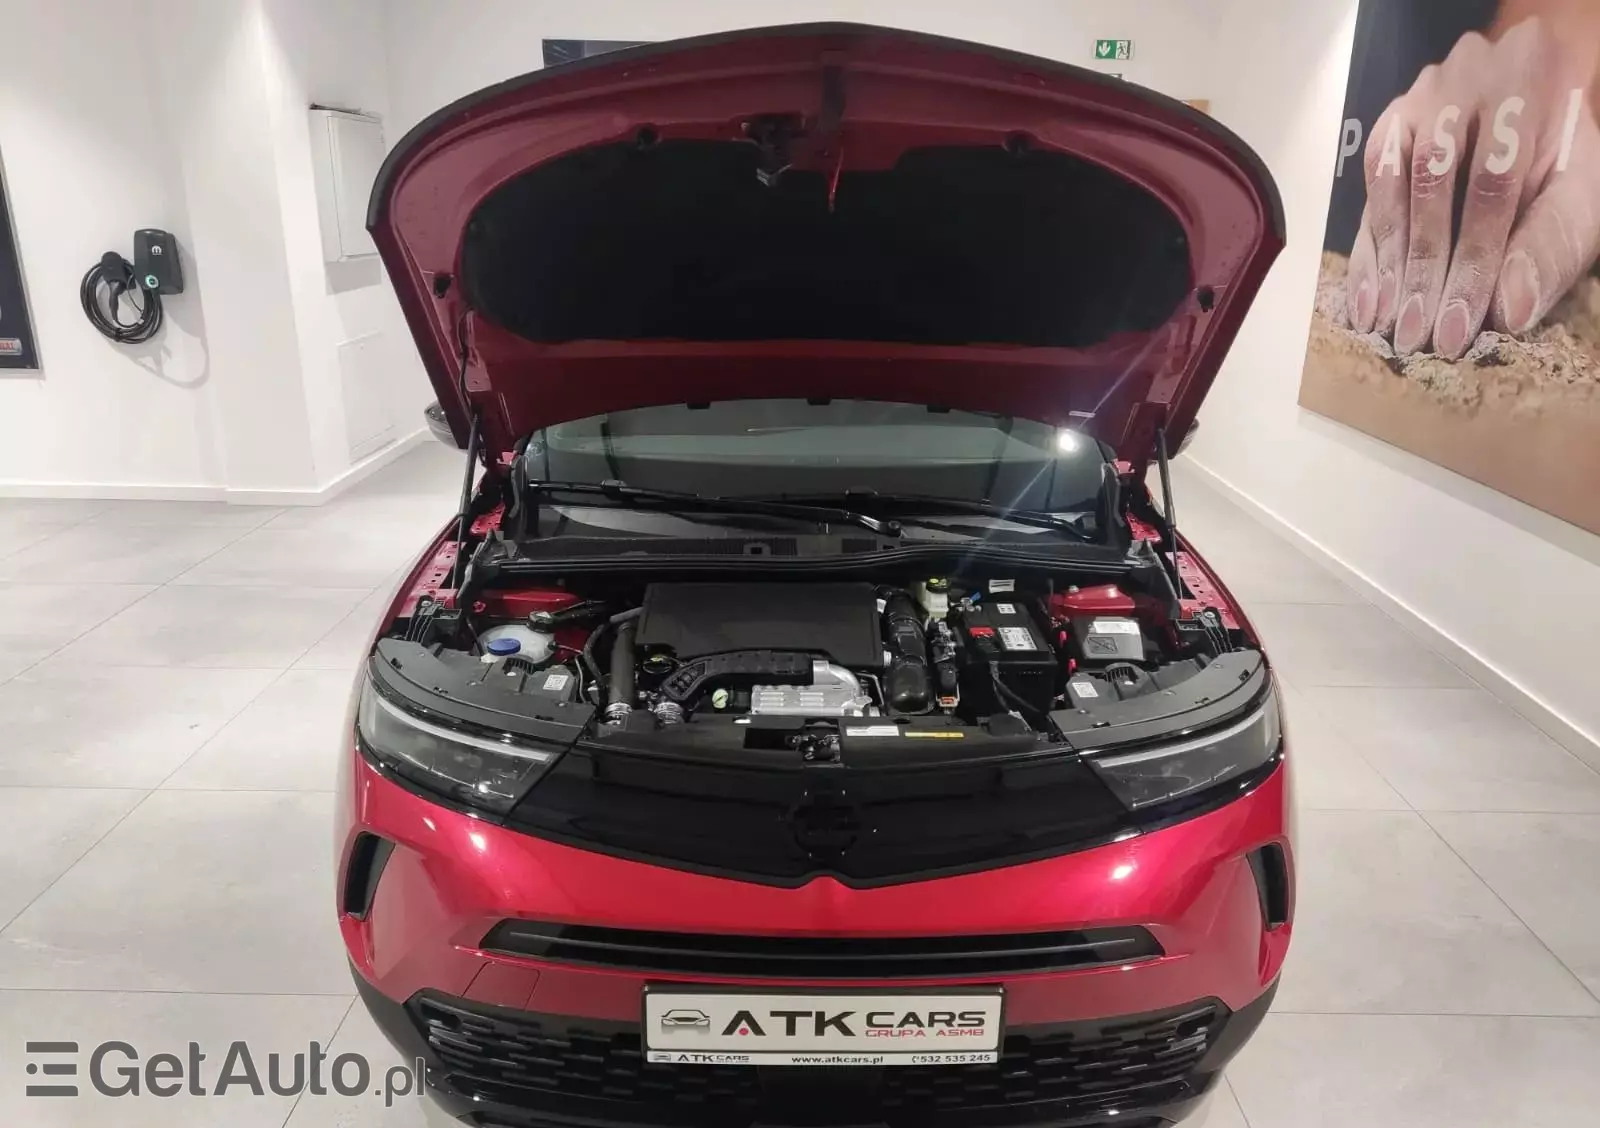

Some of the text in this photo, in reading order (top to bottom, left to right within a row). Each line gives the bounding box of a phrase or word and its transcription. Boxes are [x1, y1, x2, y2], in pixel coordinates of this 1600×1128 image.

[721, 1010, 987, 1037] ATK CARS
[865, 1028, 985, 1038] GRUPA ASMB
[677, 1054, 714, 1063] ATK
[791, 1055, 884, 1064] www.atkcars.pl
[920, 1054, 991, 1063] 532 535 245
